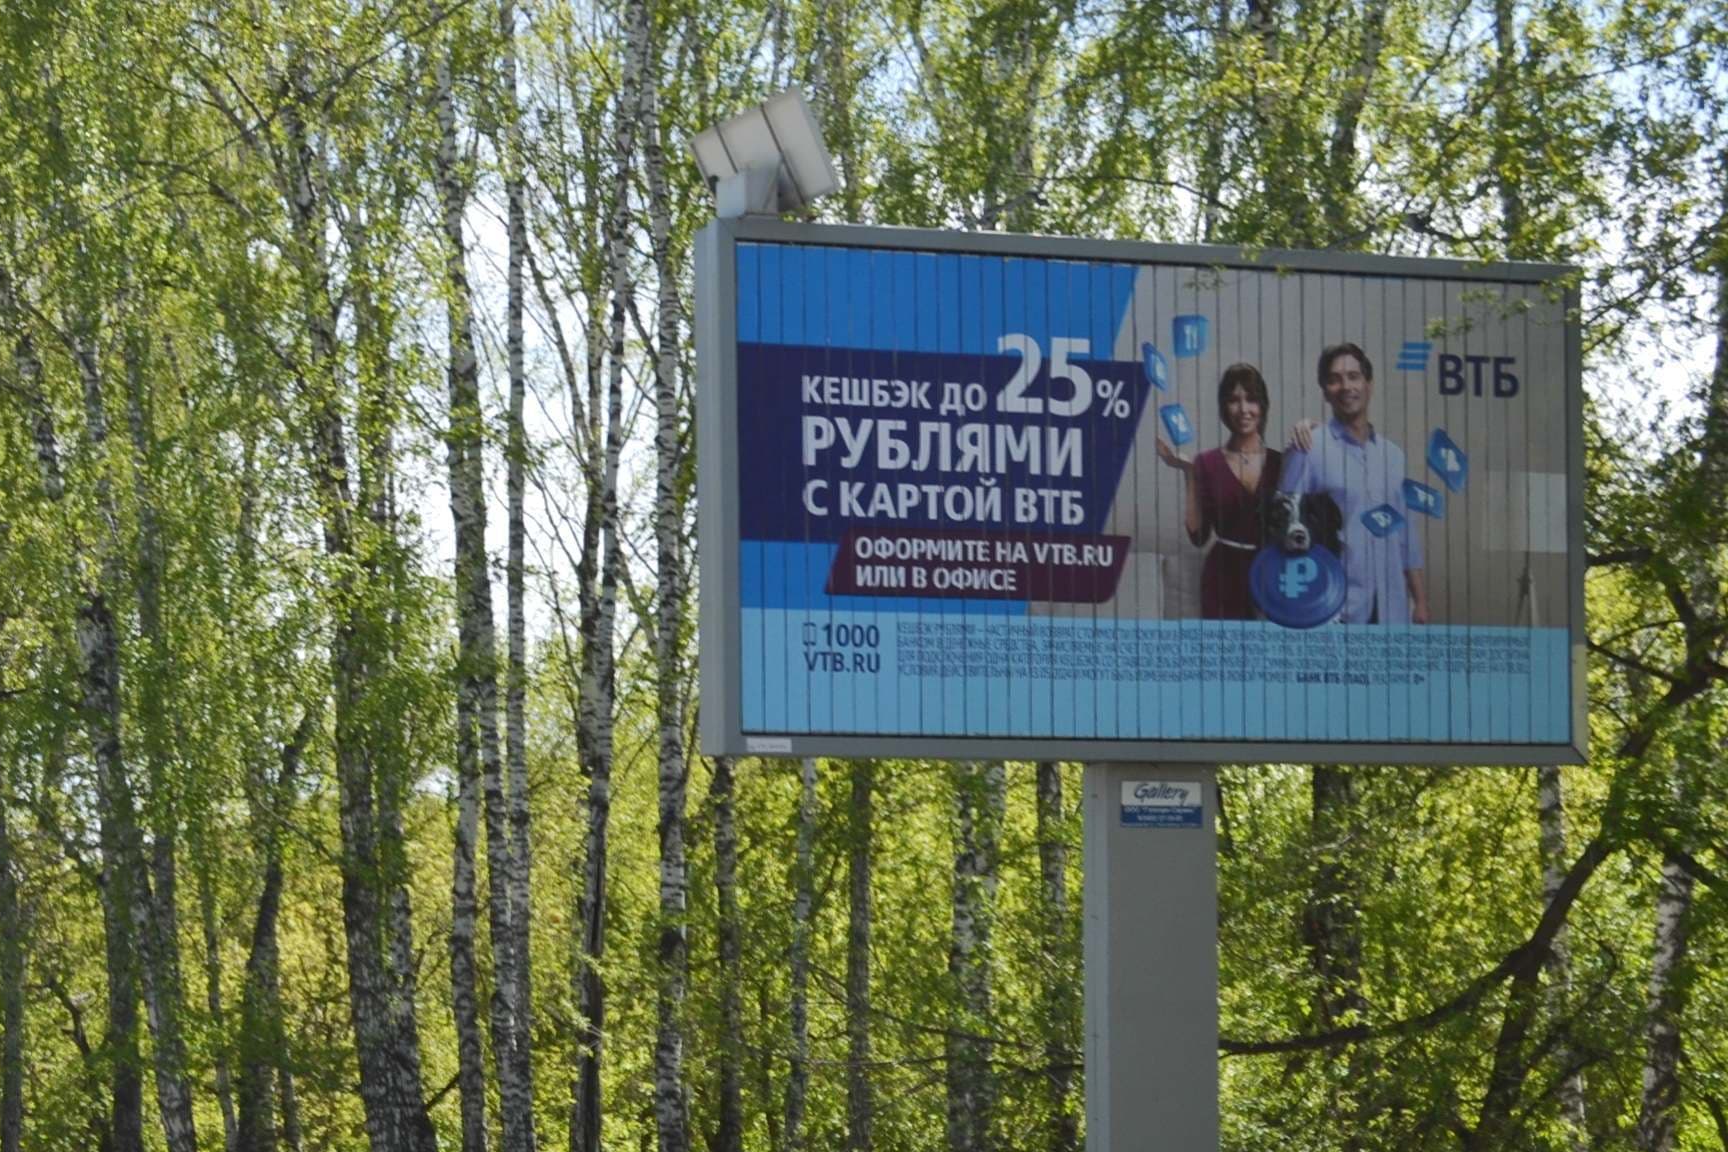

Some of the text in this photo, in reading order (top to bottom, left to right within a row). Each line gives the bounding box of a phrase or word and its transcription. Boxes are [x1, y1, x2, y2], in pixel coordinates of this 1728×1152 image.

[801, 333, 1130, 419] КЕШБЭК ДО 25%
[1437, 353, 1520, 398] ВТБ
[801, 415, 1083, 478] РУБЛЯМИ
[802, 477, 1085, 526] С КАРТОЙ ВТБ
[854, 535, 1114, 567] ОФОРМИТЕ НА VTB.RU
[855, 565, 1018, 591] ИЛИ В ОФИСЕ
[821, 623, 881, 647] 1000
[803, 651, 881, 674] VTB.RU
[1134, 783, 1190, 806] Gallery
